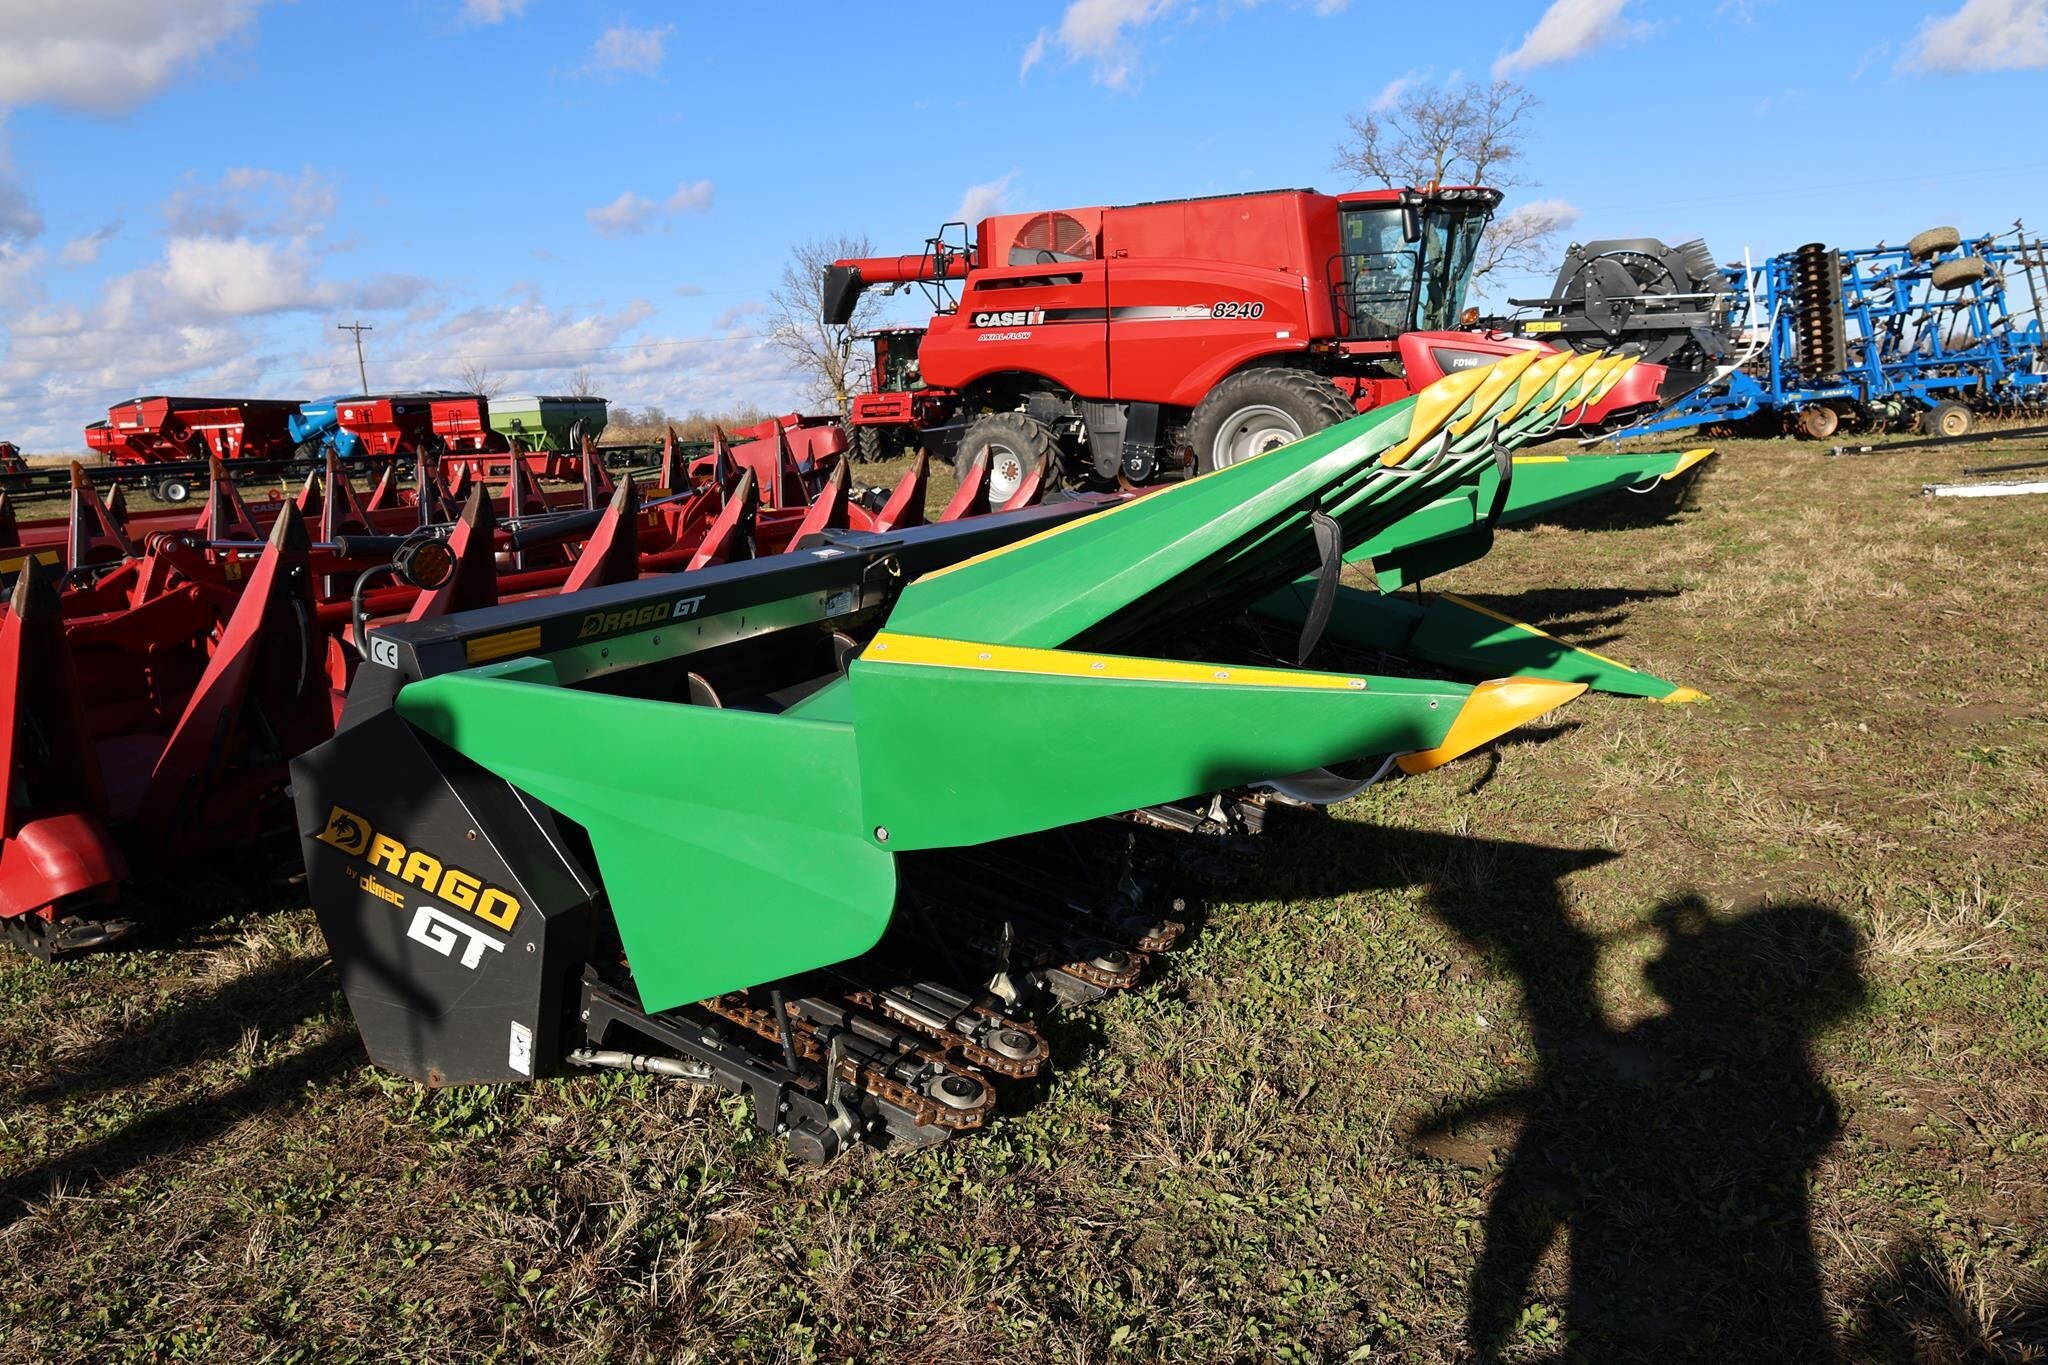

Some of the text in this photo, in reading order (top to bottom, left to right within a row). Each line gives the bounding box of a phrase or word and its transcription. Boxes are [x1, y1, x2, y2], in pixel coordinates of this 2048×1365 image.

[976, 312, 1026, 327] CASE
[1212, 302, 1264, 319] 8240
[979, 333, 1031, 341] AXIAL-FLOW
[252, 503, 282, 512] CASE
[577, 595, 706, 639] DRAGO GT
[374, 641, 395, 665] CE
[315, 805, 521, 932] DRAGO
[345, 865, 405, 909] by olimac
[406, 905, 506, 970] GT
